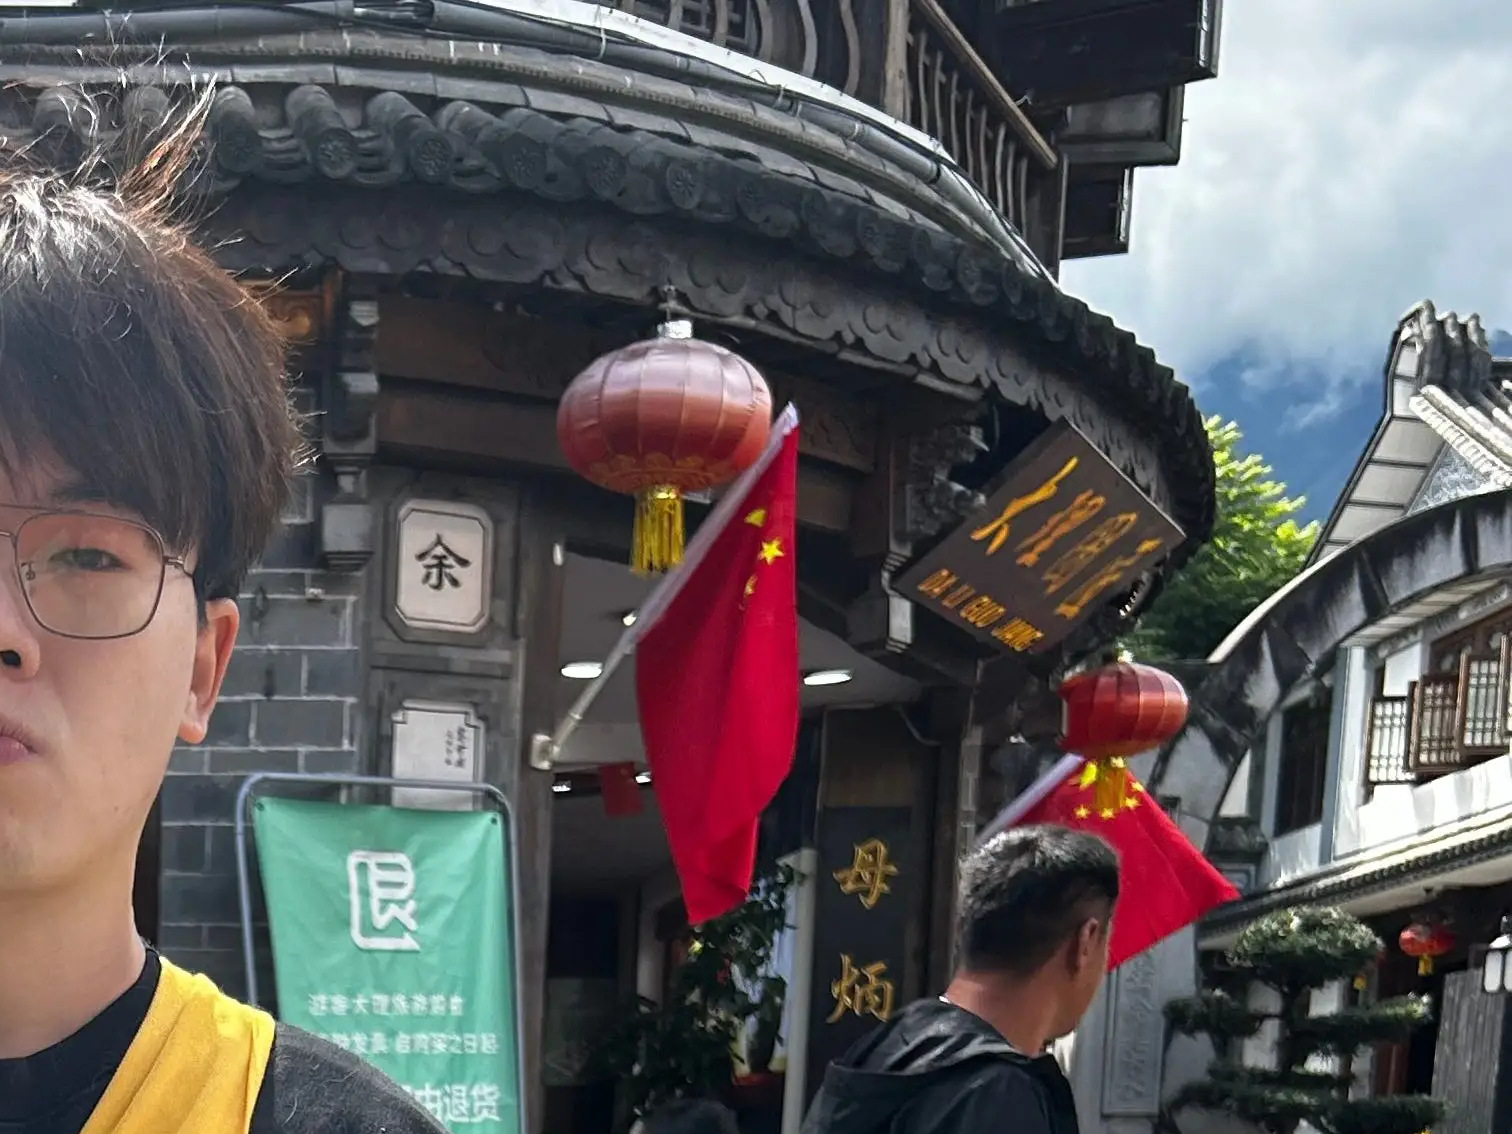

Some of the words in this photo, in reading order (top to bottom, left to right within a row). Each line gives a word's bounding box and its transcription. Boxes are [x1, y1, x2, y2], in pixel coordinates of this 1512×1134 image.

[414, 533, 472, 591] 余
[826, 838, 899, 1024] 母炳
[401, 1083, 502, 1122] 由退货
